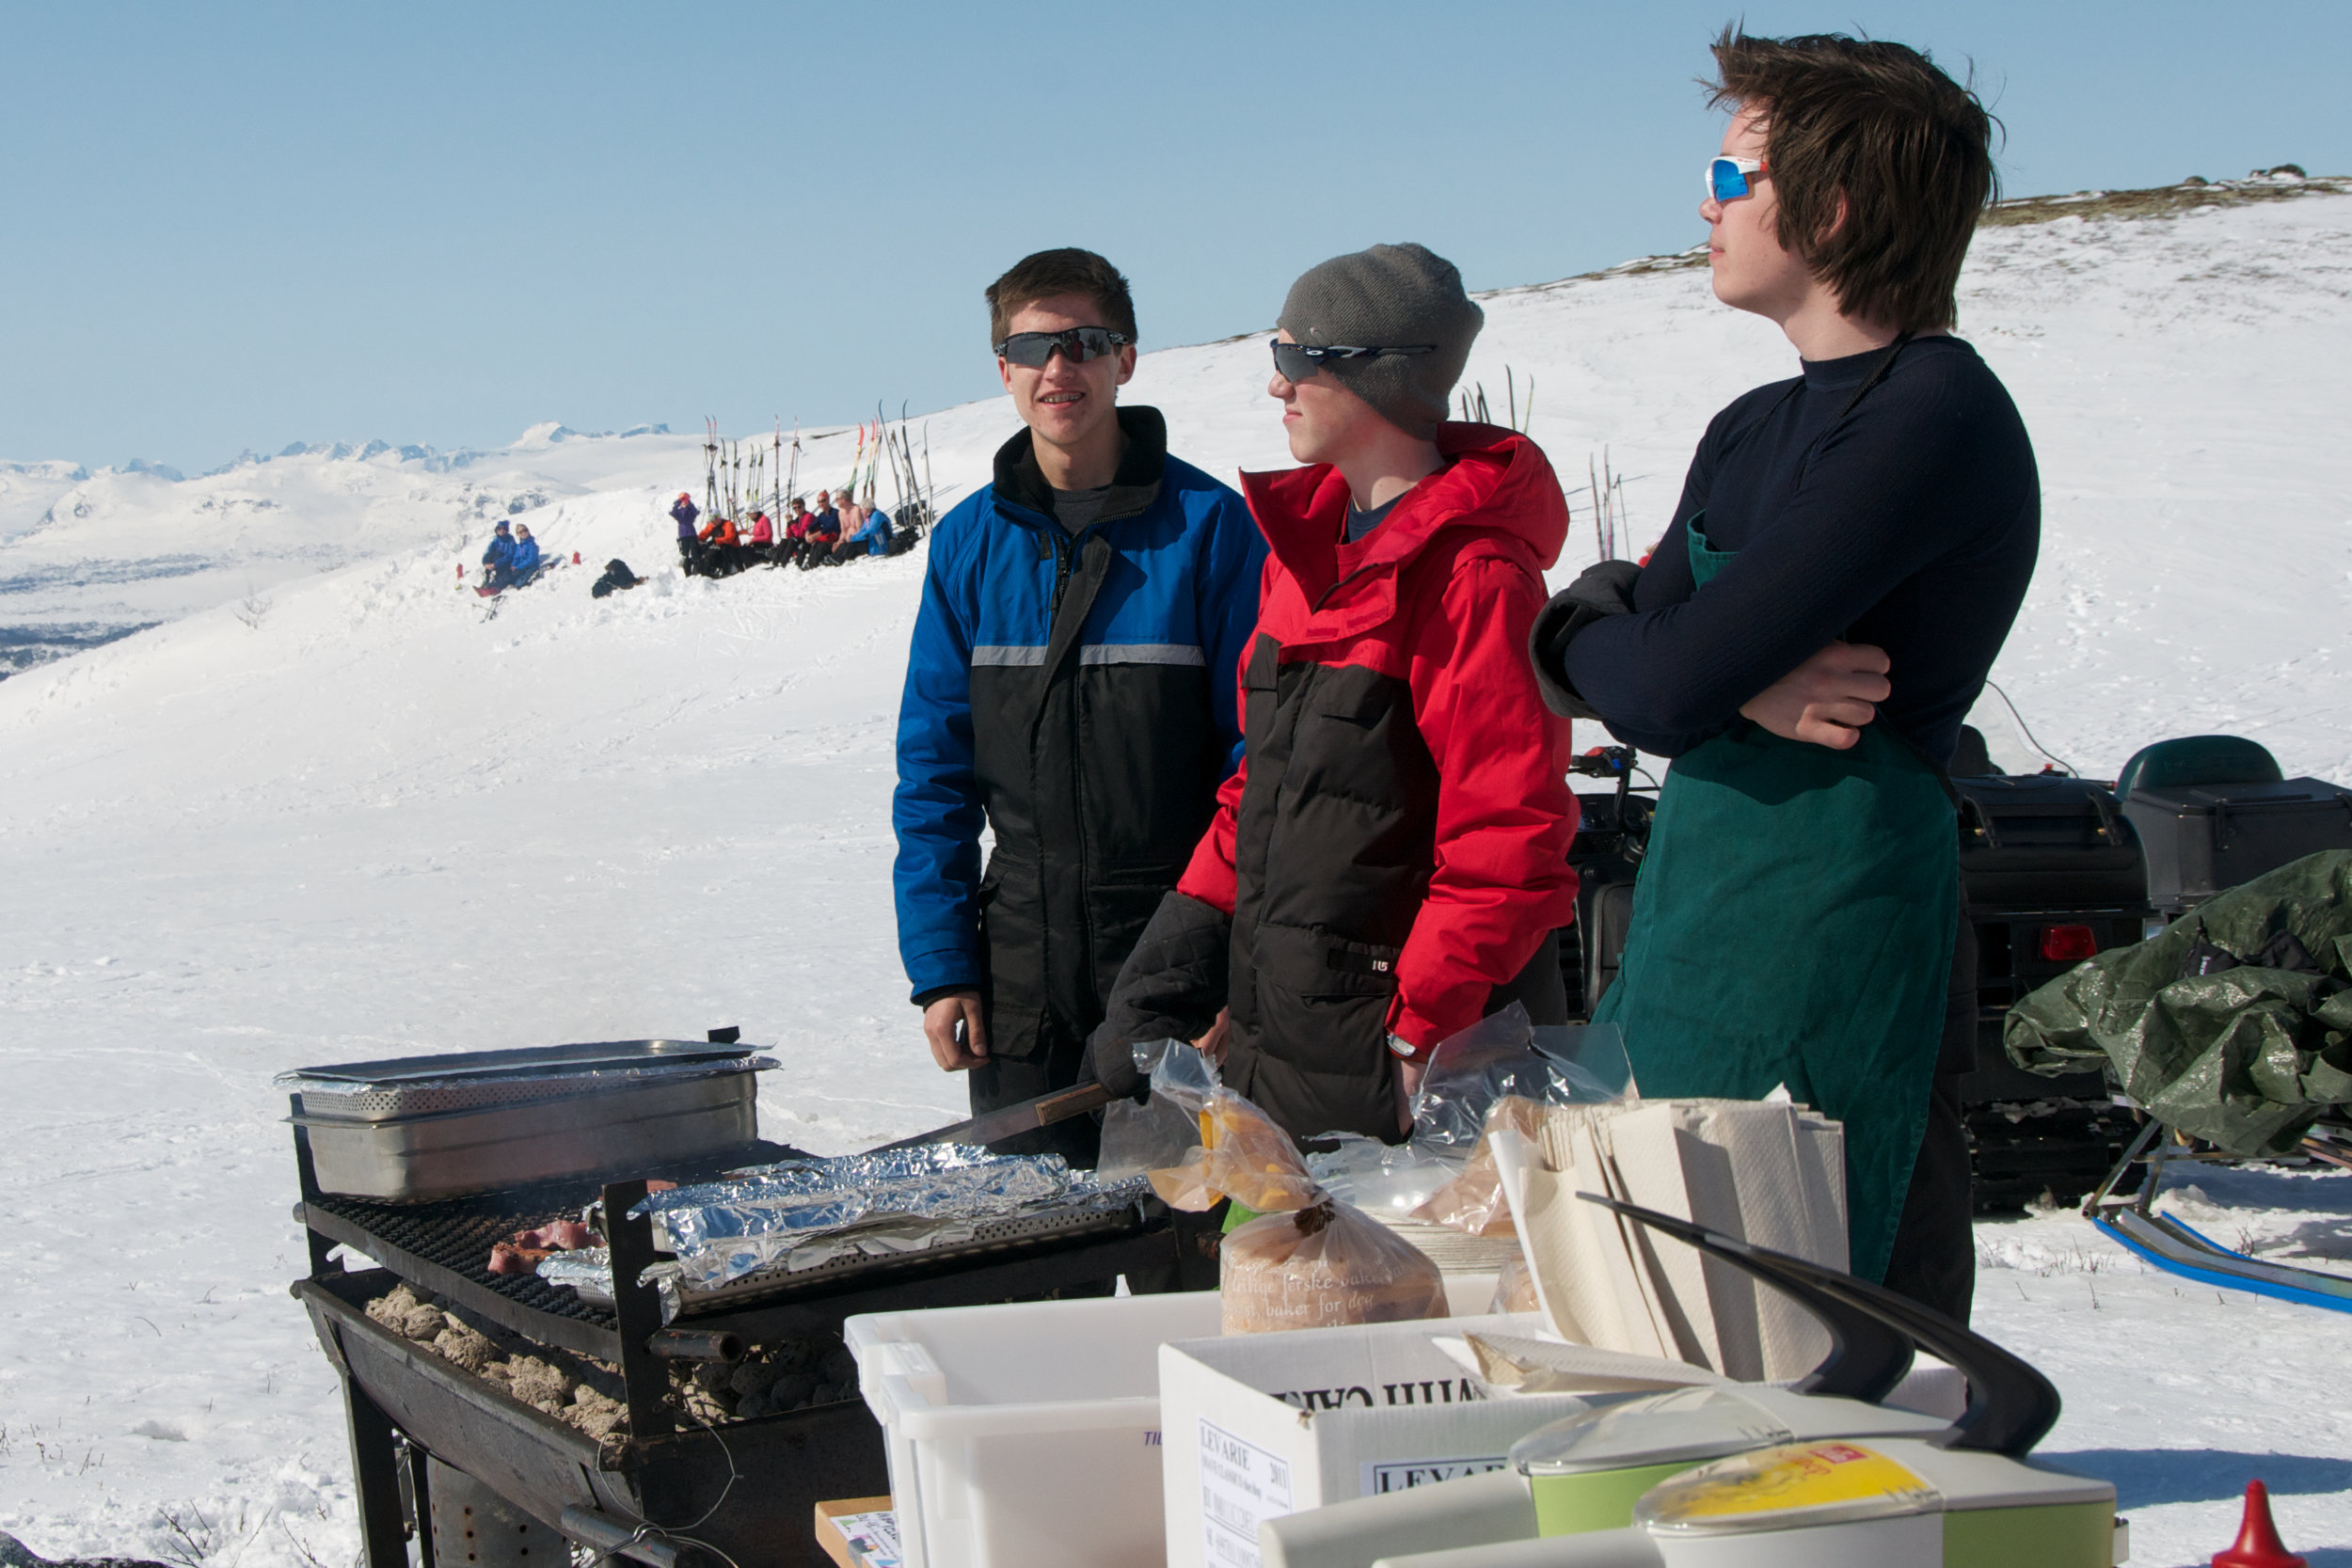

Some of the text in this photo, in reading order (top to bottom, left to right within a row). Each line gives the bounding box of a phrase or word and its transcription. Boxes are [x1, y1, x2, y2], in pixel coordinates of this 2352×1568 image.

[1281, 1272, 1333, 1304] ferske
[1265, 1298, 1310, 1318] baker
[1317, 1293, 1342, 1319] for
[1348, 1290, 1374, 1311] deg
[1200, 1425, 1250, 1471] LEVARIE
